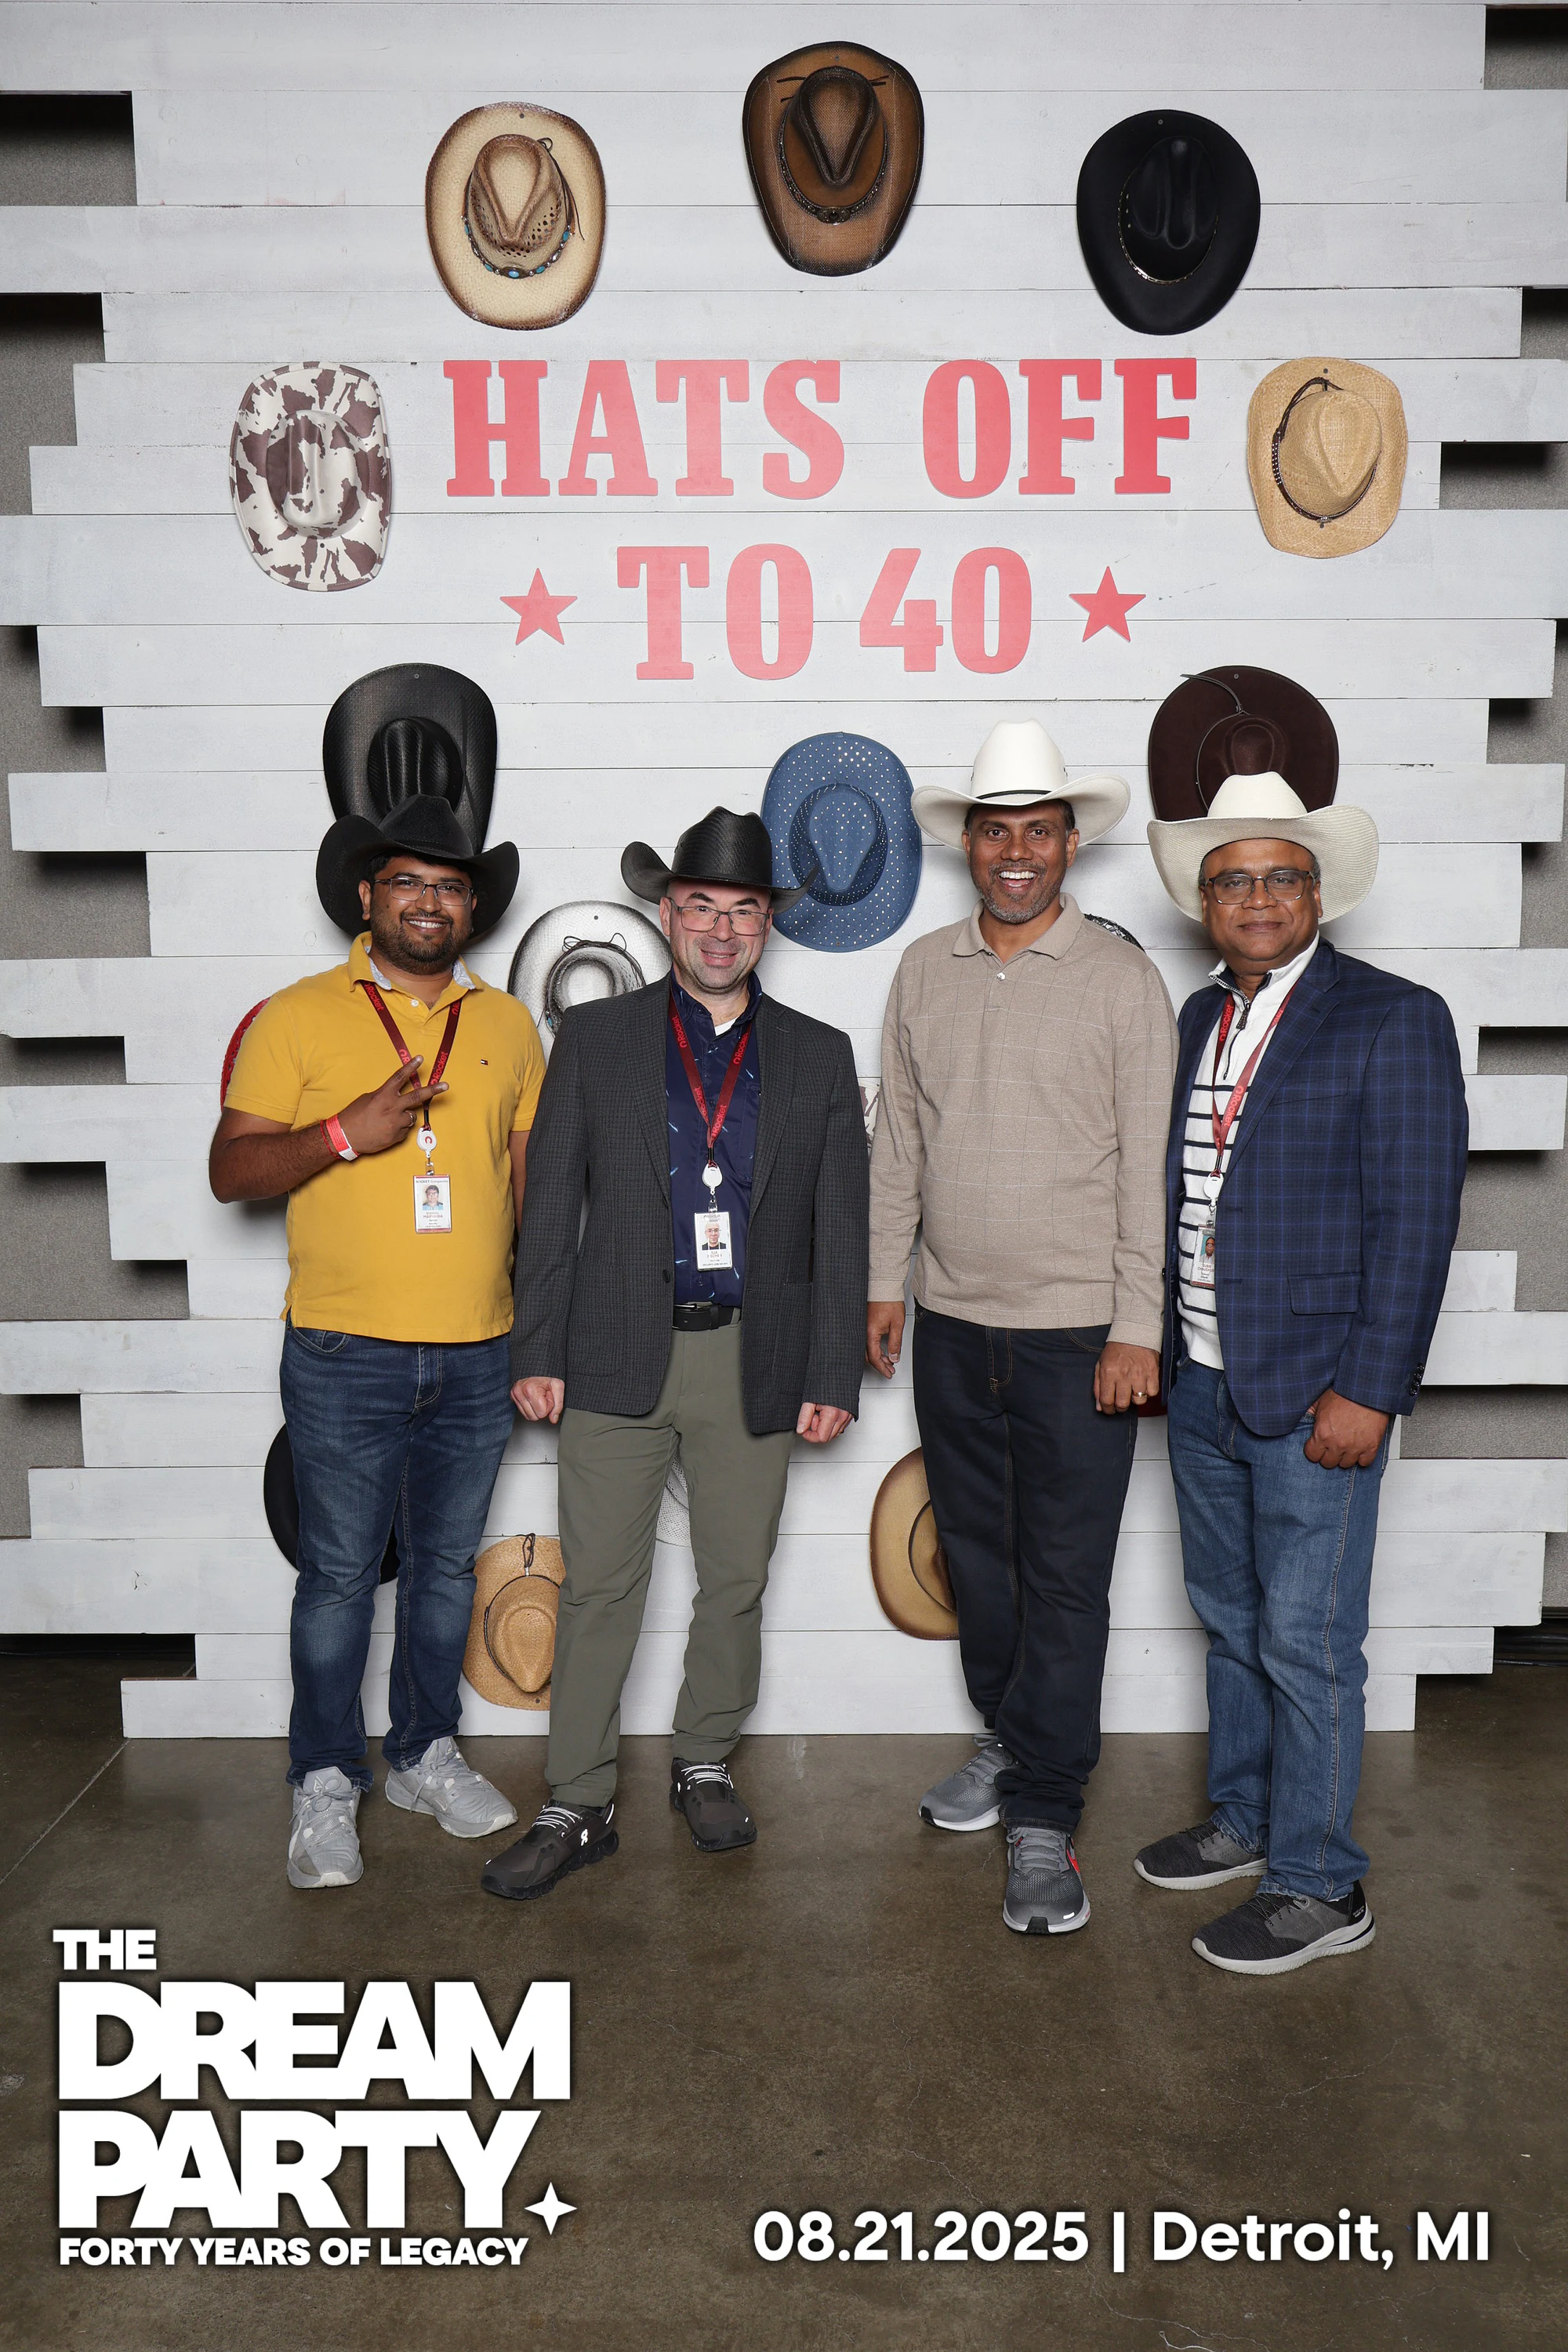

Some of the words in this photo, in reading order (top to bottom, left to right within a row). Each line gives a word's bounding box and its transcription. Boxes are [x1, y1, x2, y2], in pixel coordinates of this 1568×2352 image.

[444, 359, 844, 499] HATS
[924, 358, 1197, 498] OFF
[618, 544, 813, 679] TO
[861, 547, 1032, 674] 40
[365, 986, 385, 1011] Rocket
[672, 1015, 687, 1044] Rocket
[1221, 1004, 1234, 1033] Rocket
[432, 1051, 449, 1080] Rocket
[712, 1105, 728, 1134] Rocket
[1224, 1094, 1243, 1127] Rocket
